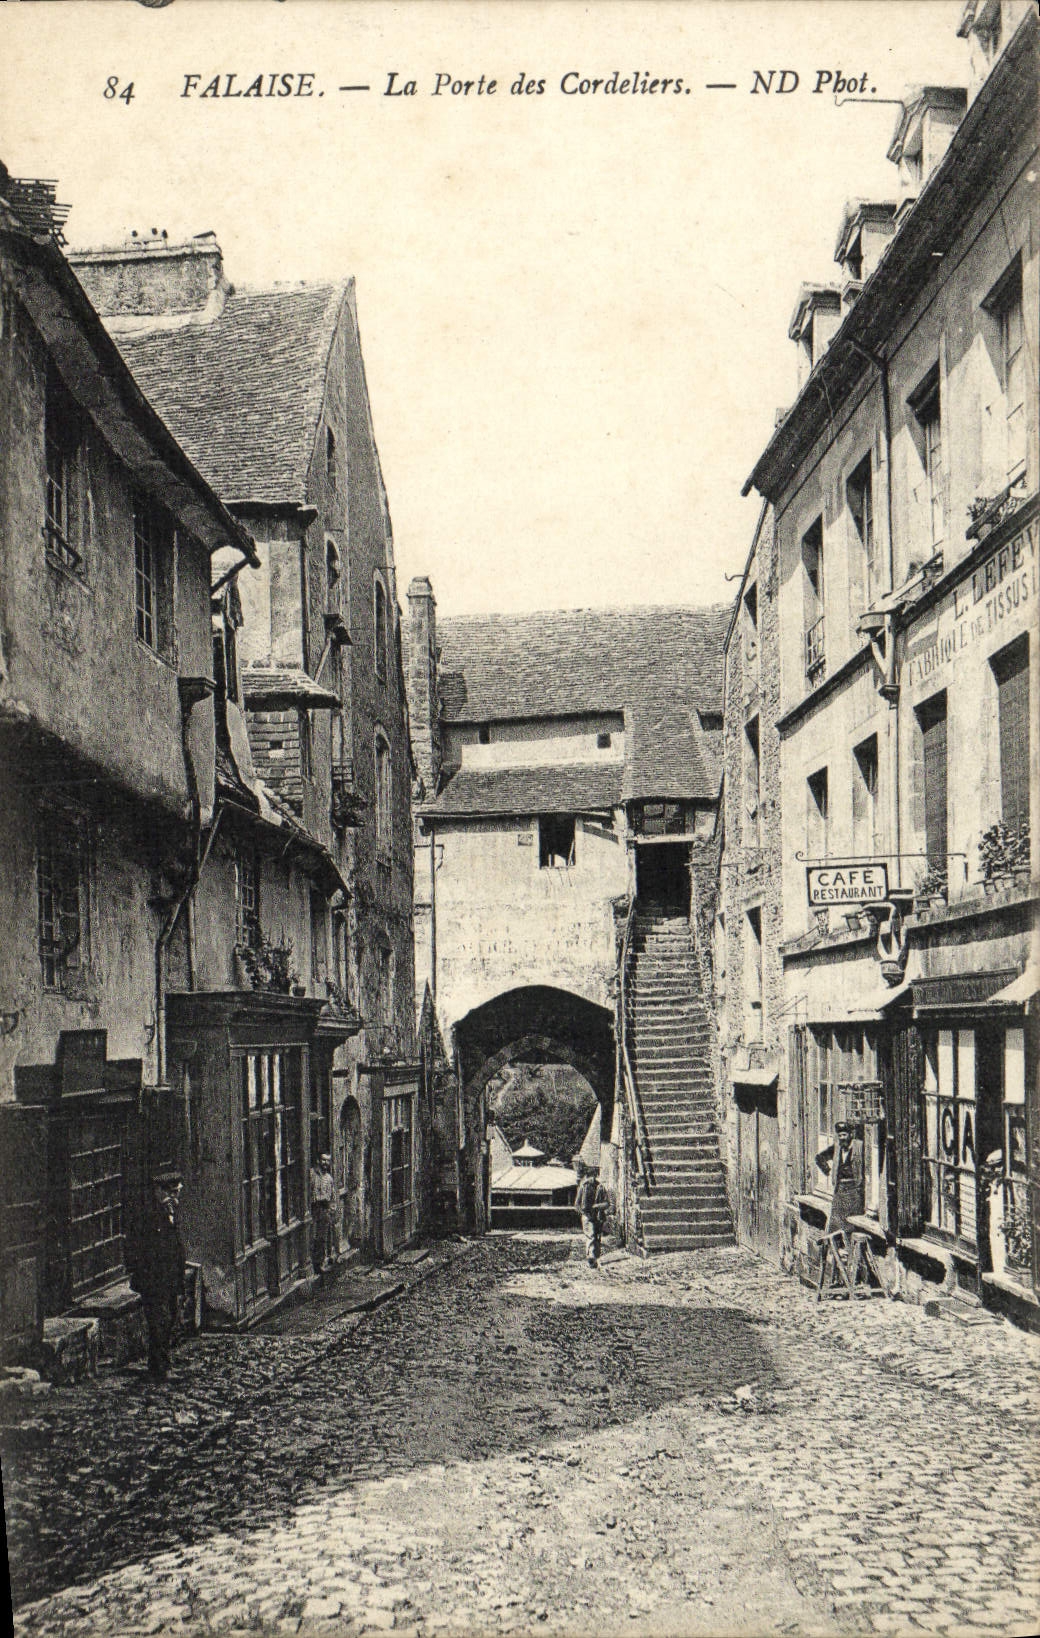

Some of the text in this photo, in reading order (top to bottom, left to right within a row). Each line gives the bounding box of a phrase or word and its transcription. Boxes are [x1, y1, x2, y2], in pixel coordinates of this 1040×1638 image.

[952, 590, 969, 620] L.
[985, 572, 1029, 633] TISSUS
[813, 886, 884, 901] RESTAURANT
